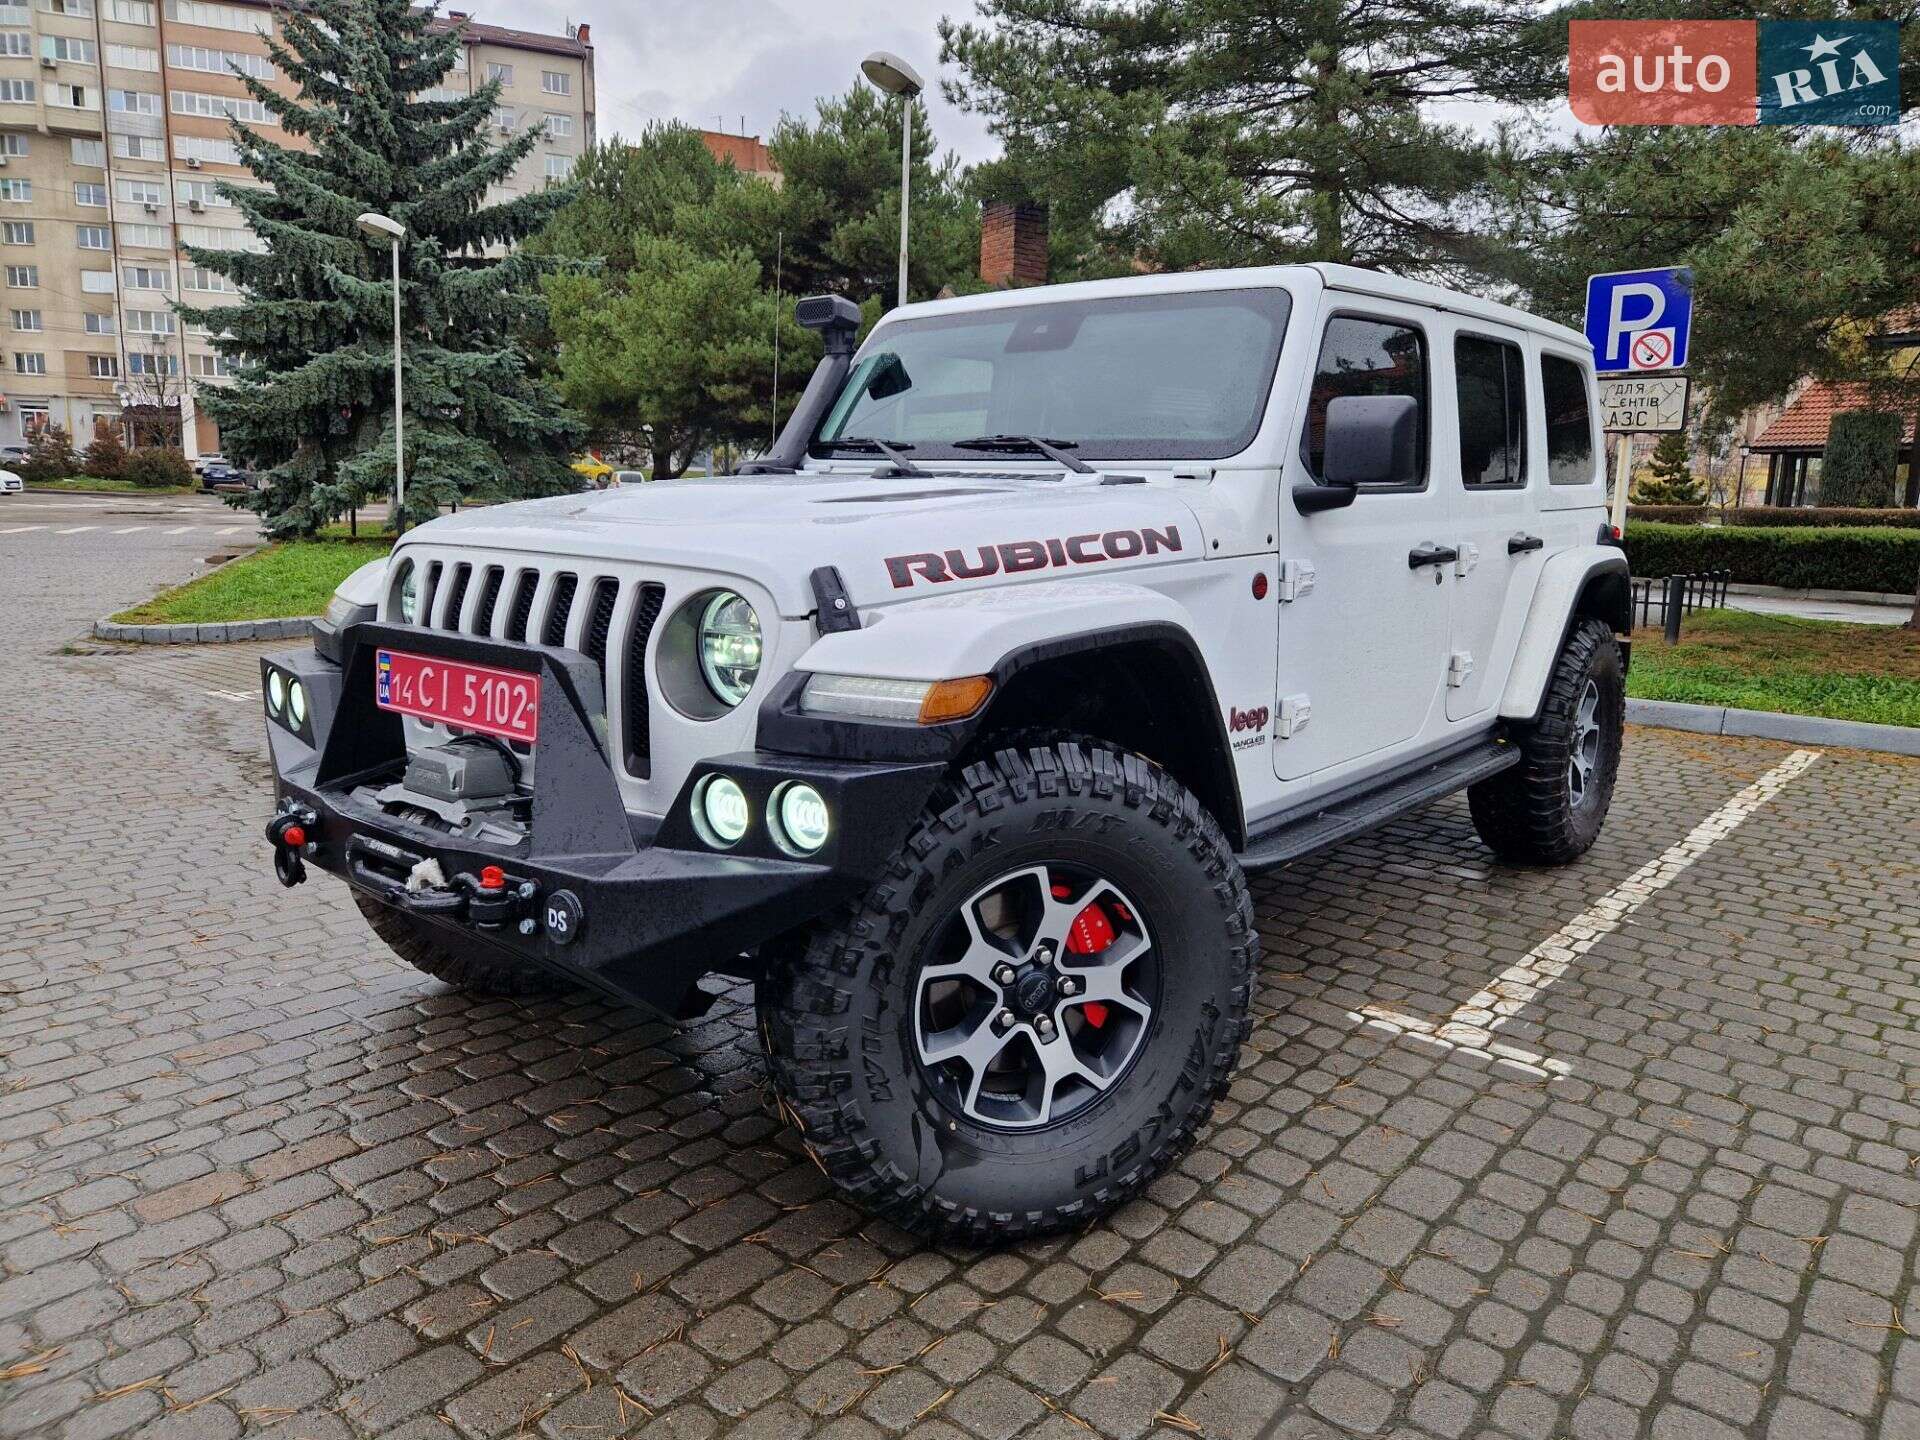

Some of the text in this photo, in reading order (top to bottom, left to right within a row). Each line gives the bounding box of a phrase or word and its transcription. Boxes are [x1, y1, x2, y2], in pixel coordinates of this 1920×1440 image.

[1605, 282, 1666, 360] P
[1616, 383, 1645, 395] ДЛЯ
[1600, 397, 1659, 408] КЄНТІВ
[1610, 411, 1648, 426] АЗС
[884, 525, 1183, 588] RUBICON
[379, 683, 390, 698] UA
[463, 674, 528, 729] 5102
[1229, 706, 1269, 733] Jeep
[548, 907, 567, 932] DS
